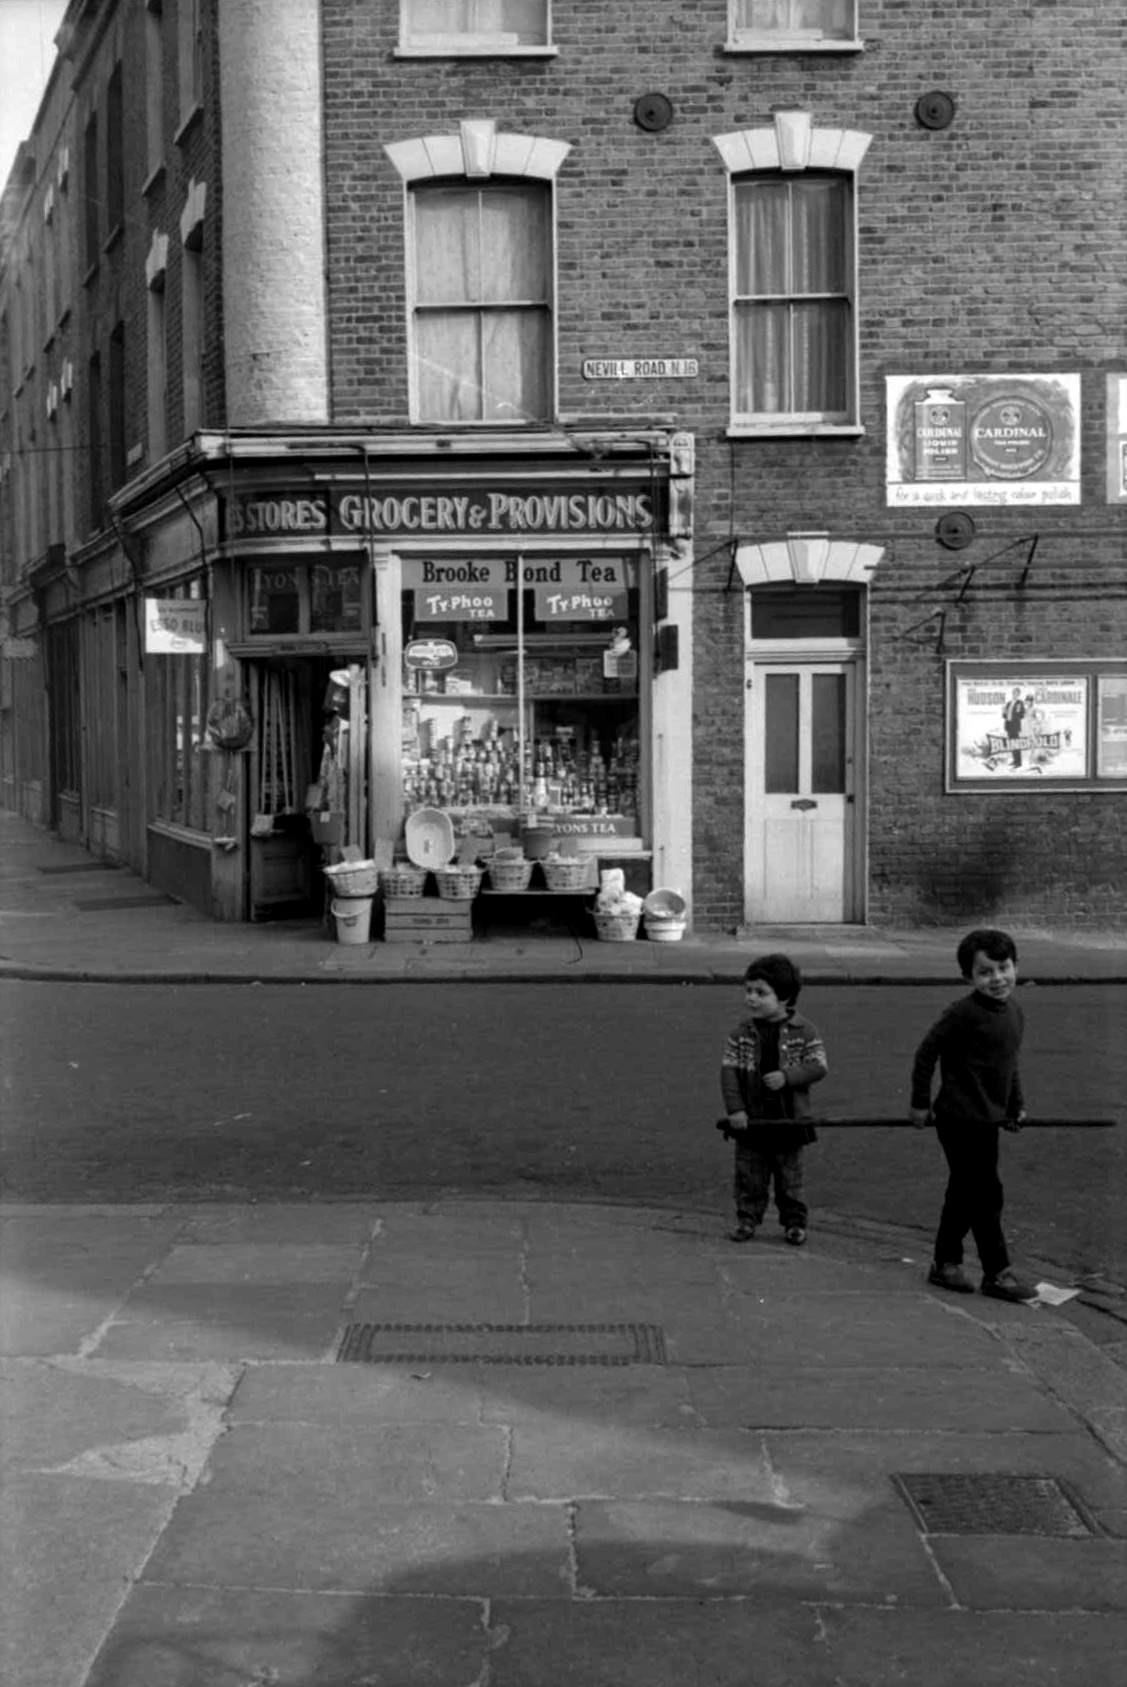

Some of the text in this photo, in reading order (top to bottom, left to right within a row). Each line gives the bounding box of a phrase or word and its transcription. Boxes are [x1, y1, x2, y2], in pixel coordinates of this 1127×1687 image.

[586, 361, 628, 376] NEVILL
[634, 361, 666, 375] ROAD
[917, 427, 962, 438] CARDINAL
[975, 427, 1047, 438] CARDINAL
[247, 500, 327, 531] STORES
[339, 493, 653, 530] GROCERY & PROVISIONS
[422, 560, 617, 583] Brooke Bond Tea
[469, 609, 495, 618] TEA
[589, 609, 615, 619] TEA
[591, 823, 616, 833] TEA
